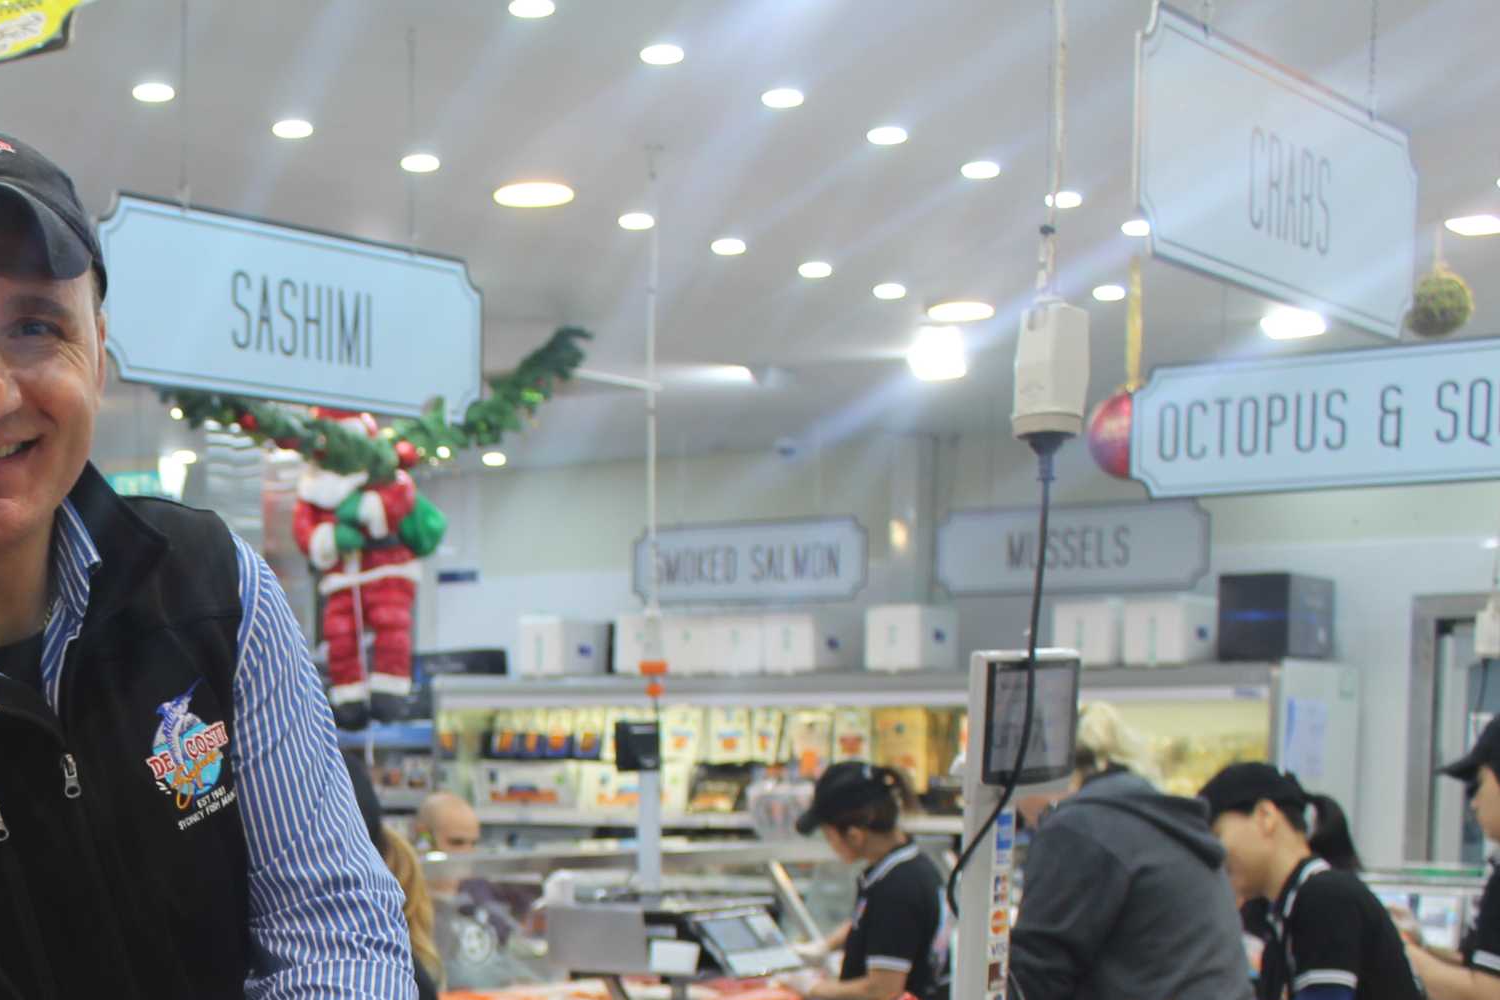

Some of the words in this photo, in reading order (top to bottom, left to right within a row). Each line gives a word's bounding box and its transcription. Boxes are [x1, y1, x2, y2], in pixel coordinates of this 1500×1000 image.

[1249, 125, 1332, 256] CRABS
[230, 269, 373, 369] SASHIMI
[1157, 388, 1348, 462] OCTOPUS
[1379, 384, 1403, 450] &
[1435, 377, 1500, 447] SQ
[750, 542, 841, 582] SALMON
[147, 753, 176, 780] DE
[184, 722, 229, 760] COSTI
